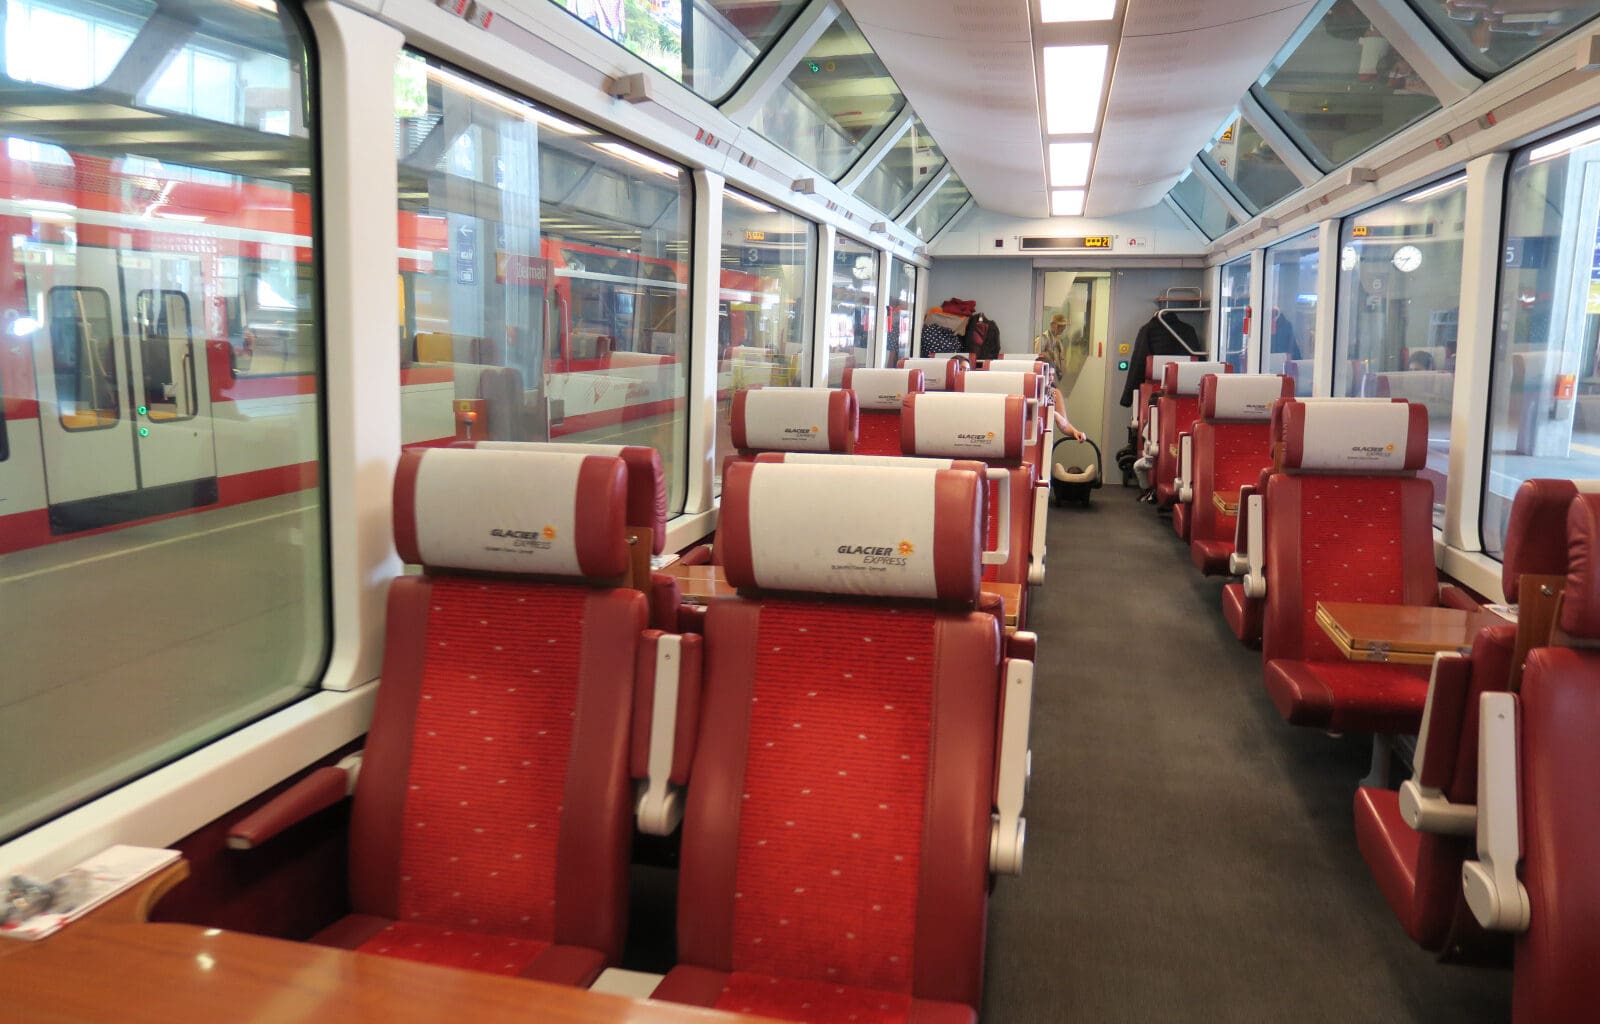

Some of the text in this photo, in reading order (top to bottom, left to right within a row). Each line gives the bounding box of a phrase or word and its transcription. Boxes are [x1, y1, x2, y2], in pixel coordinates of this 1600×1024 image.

[748, 248, 759, 262] 3
[1505, 247, 1515, 263] 5
[488, 528, 539, 539] GLACIER
[837, 545, 893, 556] GLACIER
[863, 555, 907, 566] EXPRESS
